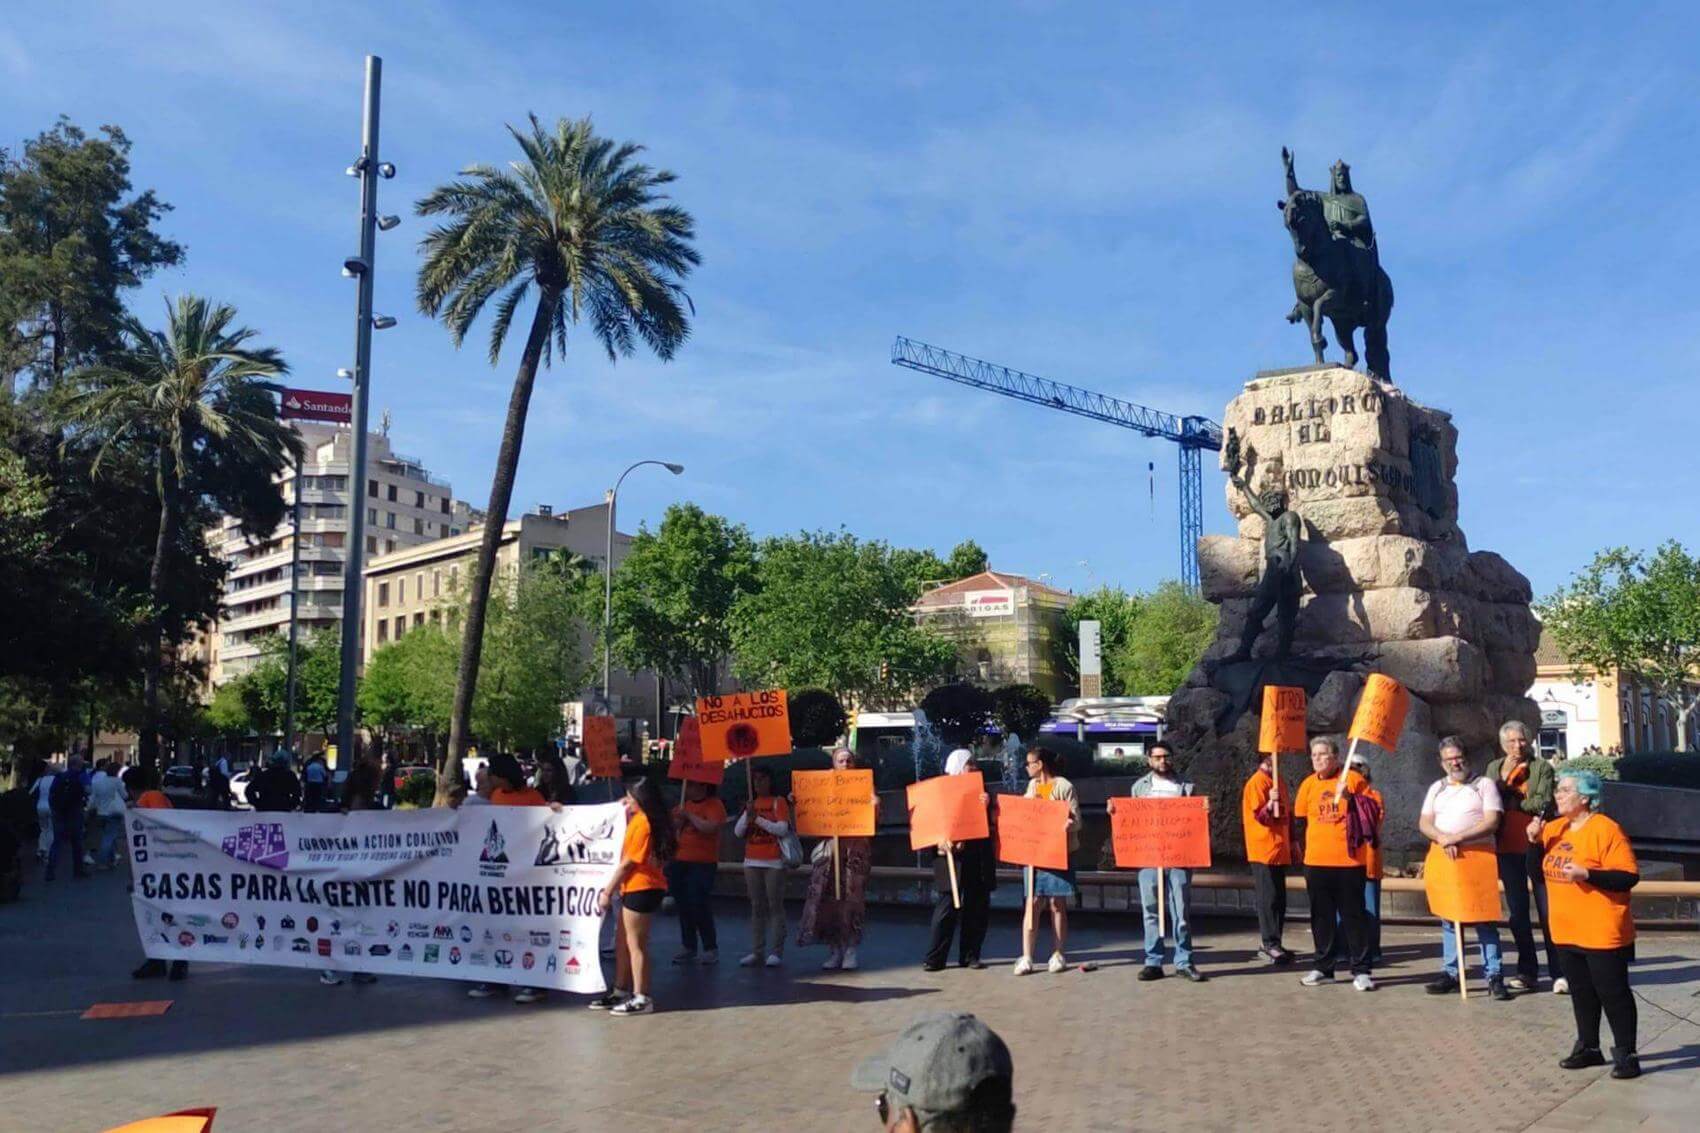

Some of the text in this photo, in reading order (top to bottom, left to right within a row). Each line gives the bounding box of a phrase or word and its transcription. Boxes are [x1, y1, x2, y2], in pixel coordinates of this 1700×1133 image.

[303, 399, 352, 413] Santand
[704, 690, 779, 710] NO A LOS
[700, 705, 784, 725] DESAHUCIOS
[298, 830, 460, 851] EUROPEAN ACTION COALITION
[141, 872, 605, 917] CASAS PARA LA GENTE NO PARA BENEFICIOS
